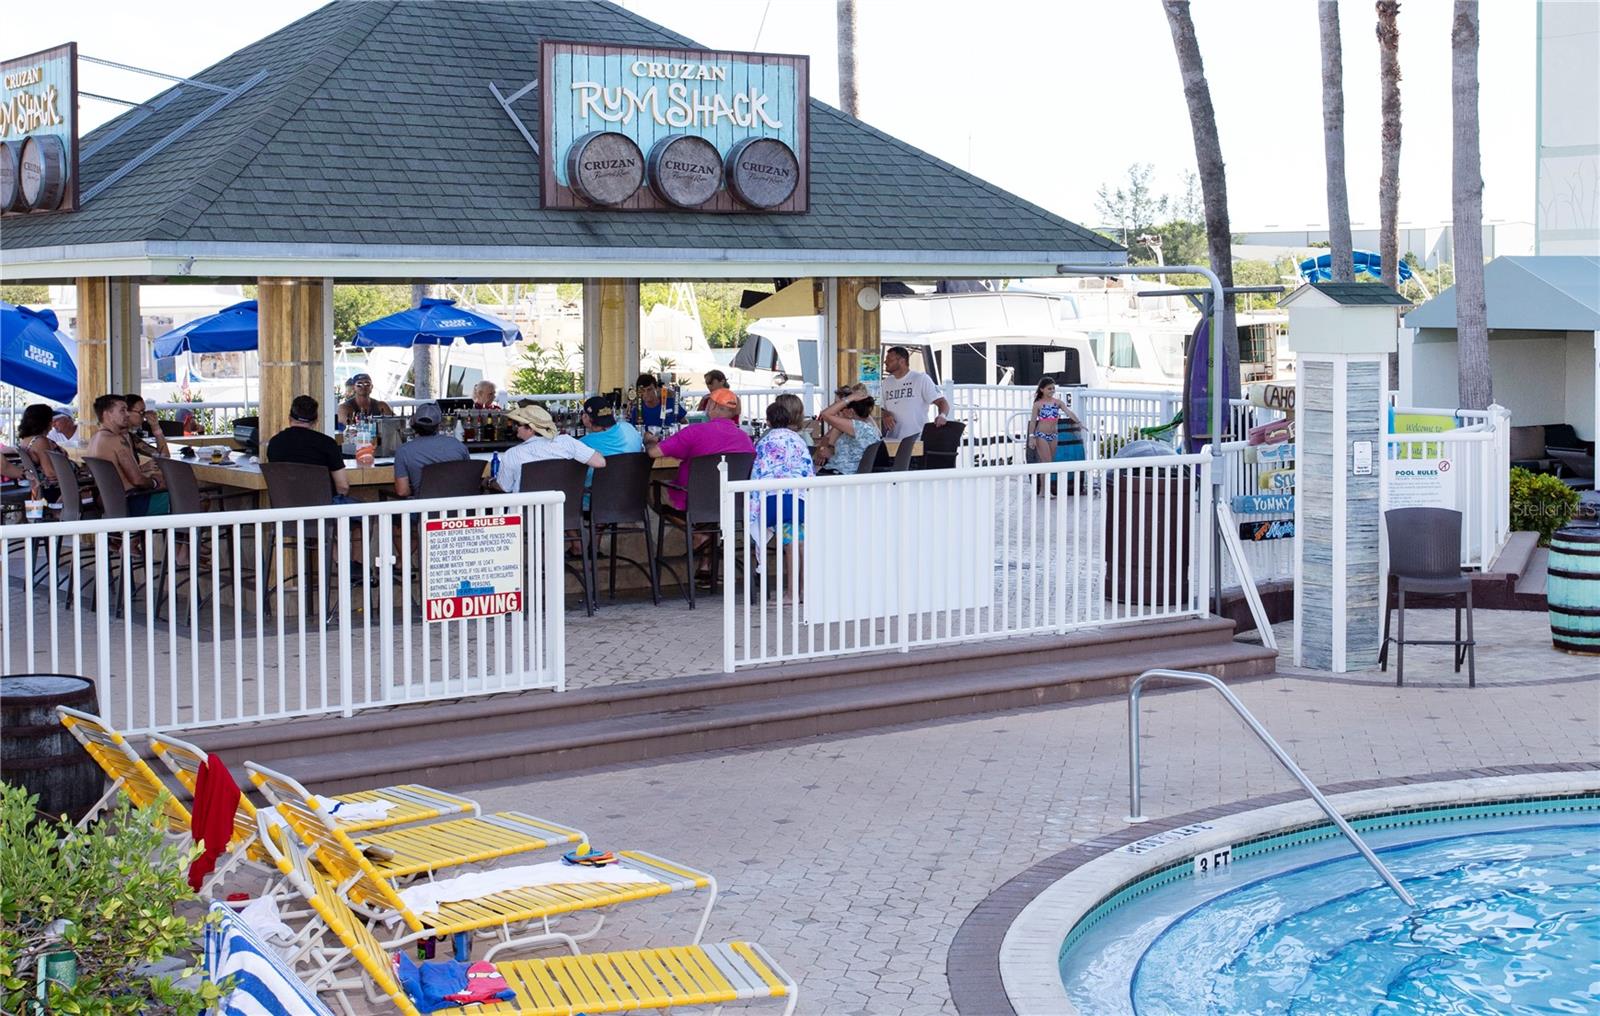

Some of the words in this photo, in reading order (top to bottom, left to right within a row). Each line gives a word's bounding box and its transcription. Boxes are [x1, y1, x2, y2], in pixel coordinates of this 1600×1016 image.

[5, 67, 42, 90] CRUZAN
[632, 61, 726, 81] CRUZAN
[17, 84, 62, 134] SHACK
[571, 81, 666, 126] RUM
[666, 82, 783, 128] SHACK
[584, 159, 635, 171] CRUZAN
[665, 160, 714, 175] CRUZAN
[742, 161, 790, 177] CRUZAN
[25, 349, 58, 369] LIGHT
[30, 344, 54, 360] BUD
[1253, 495, 1292, 511] YUMMY
[442, 521, 469, 529] POOL
[474, 518, 505, 527] RULES
[430, 599, 455, 619] NO
[462, 593, 517, 616] DIVING
[1200, 857, 1208, 872] 3
[1214, 850, 1230, 868] FT
